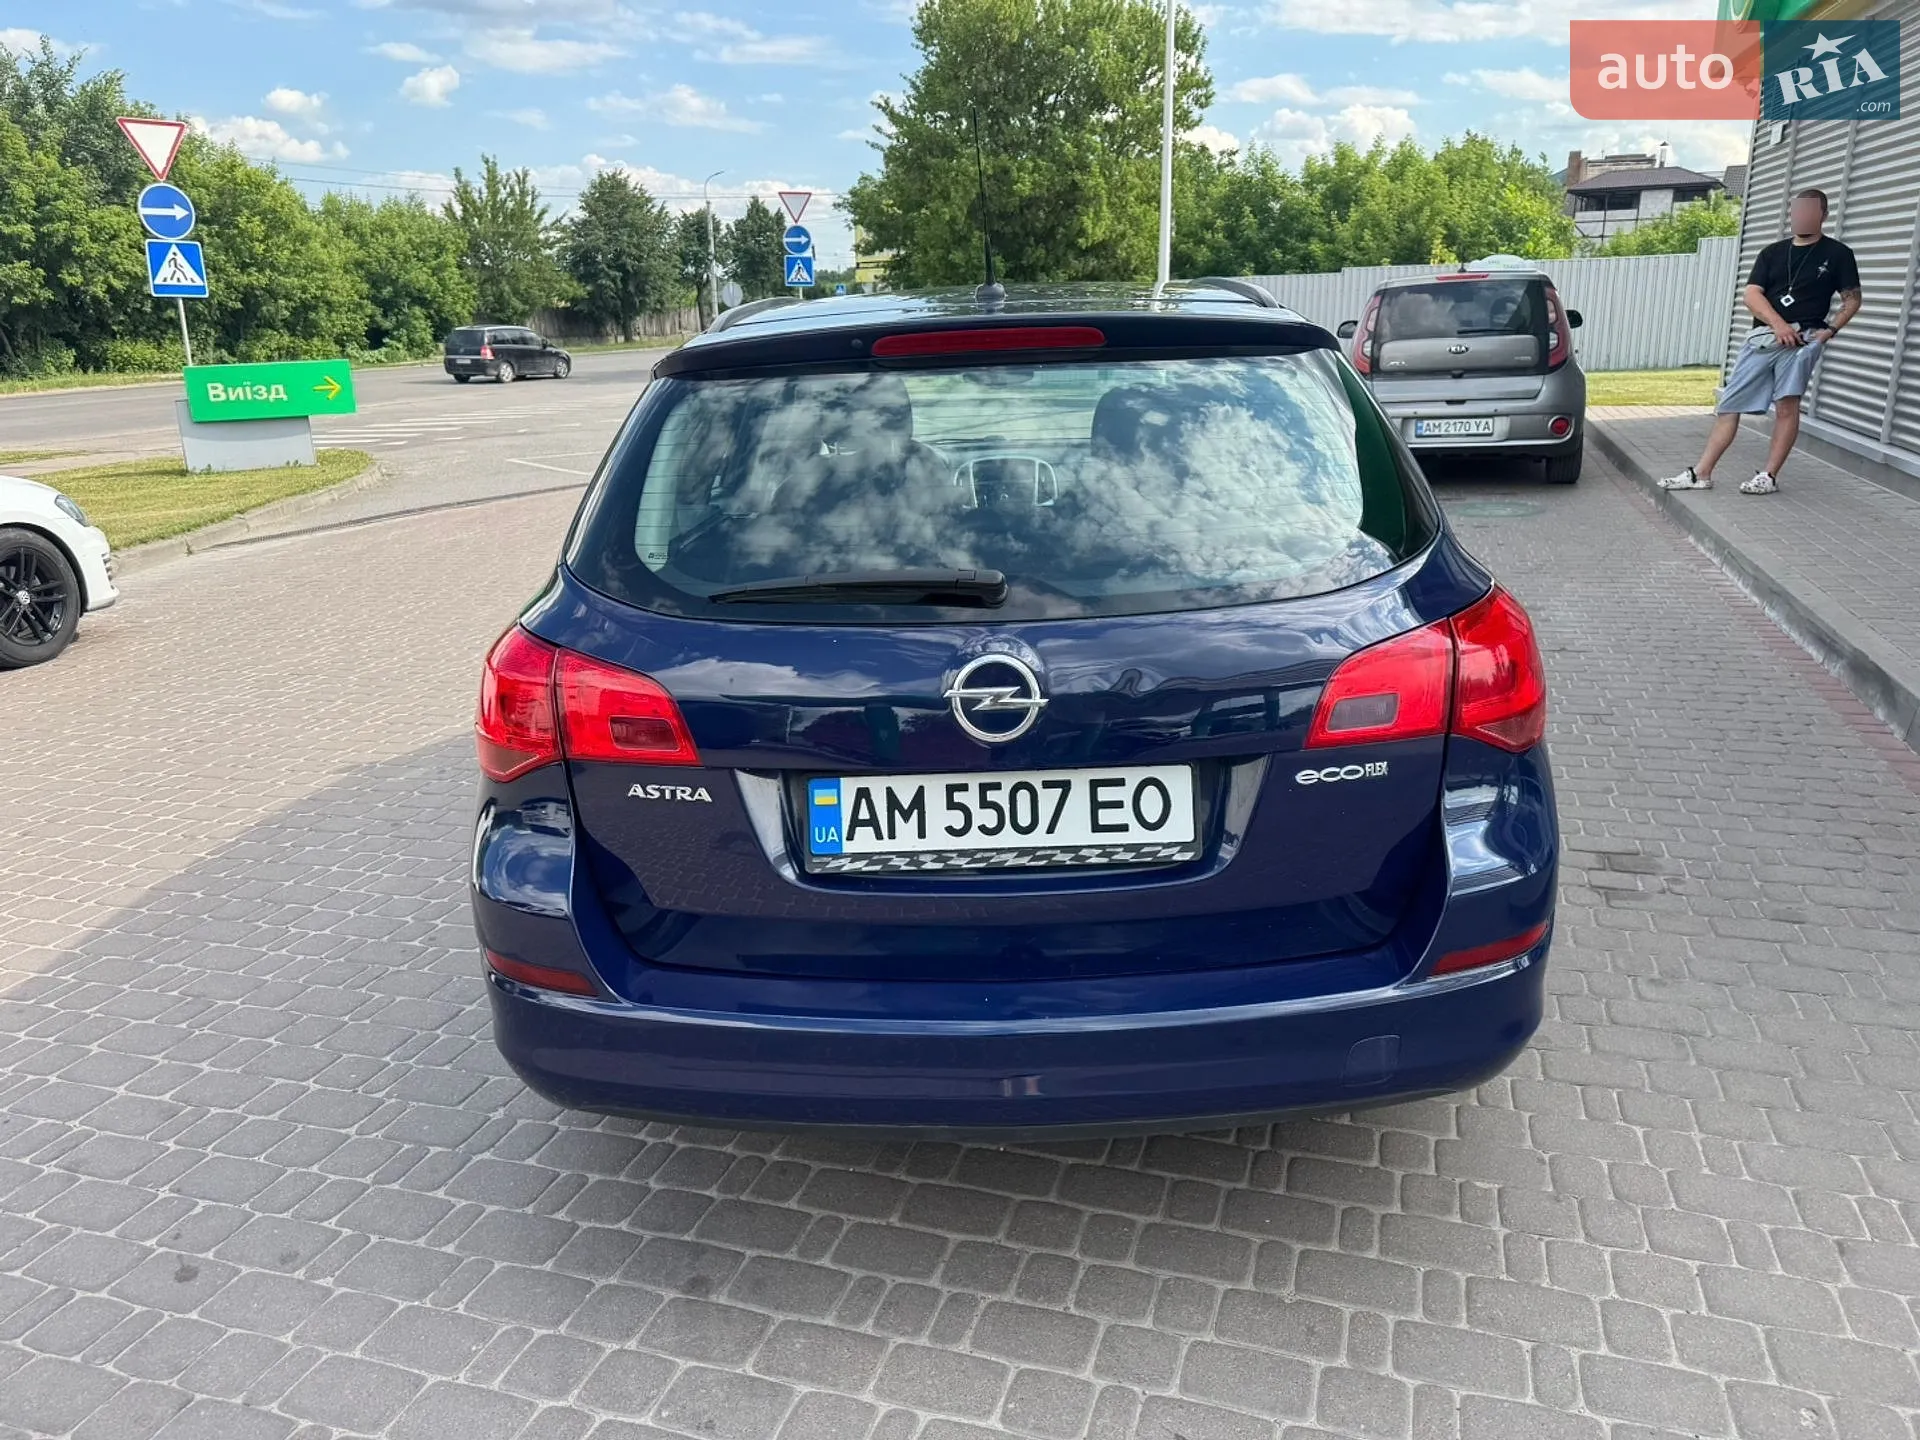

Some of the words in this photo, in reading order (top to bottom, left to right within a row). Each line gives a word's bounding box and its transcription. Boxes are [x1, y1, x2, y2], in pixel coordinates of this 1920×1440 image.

[207, 381, 288, 402] Виїзд
[1424, 423, 1442, 433] AM
[1444, 422, 1471, 432] 2170
[1475, 421, 1491, 431] YA
[628, 784, 712, 802] ASTRA
[846, 785, 926, 841] AM
[944, 779, 1072, 836] 5507
[1090, 776, 1172, 833] EO
[815, 827, 839, 843] UA
